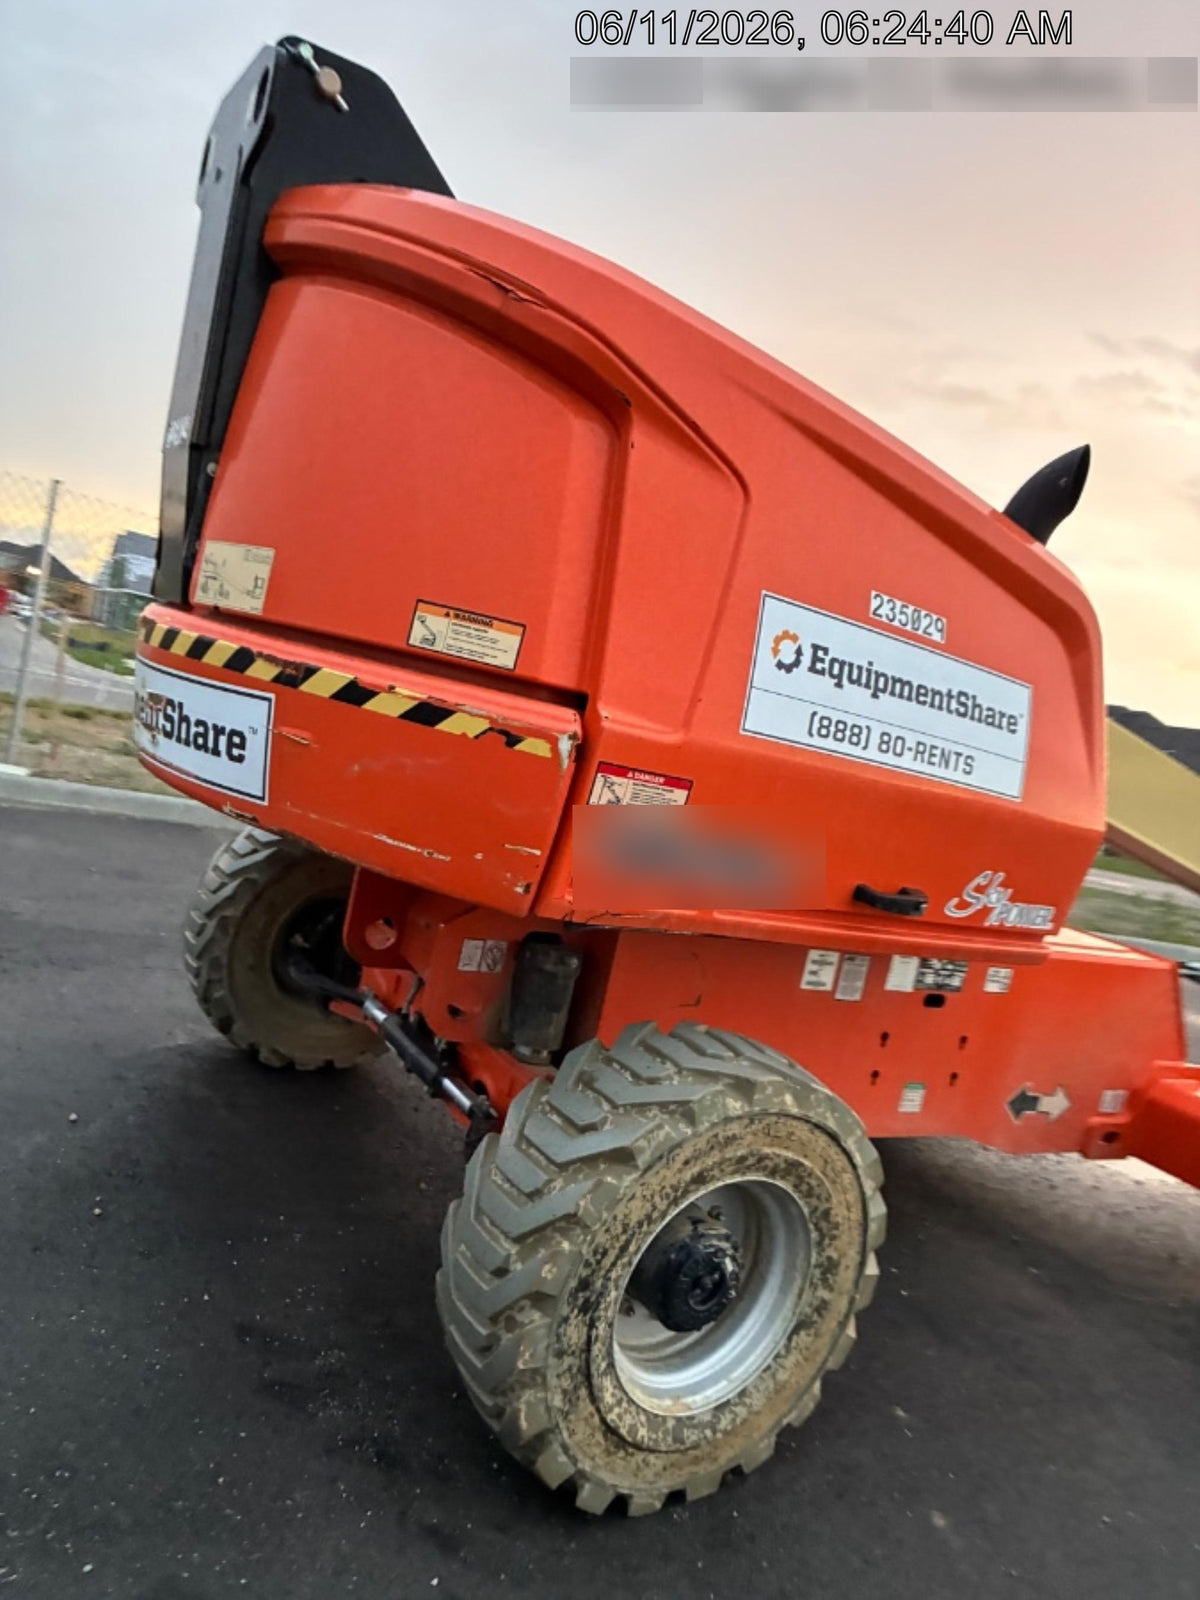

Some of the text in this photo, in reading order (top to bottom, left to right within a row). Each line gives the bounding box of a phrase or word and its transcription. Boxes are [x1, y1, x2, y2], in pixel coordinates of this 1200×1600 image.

[872, 593, 945, 641] 235029
[807, 643, 1019, 735] EquipmentShare
[808, 711, 976, 776] (888) 80-RENTS
